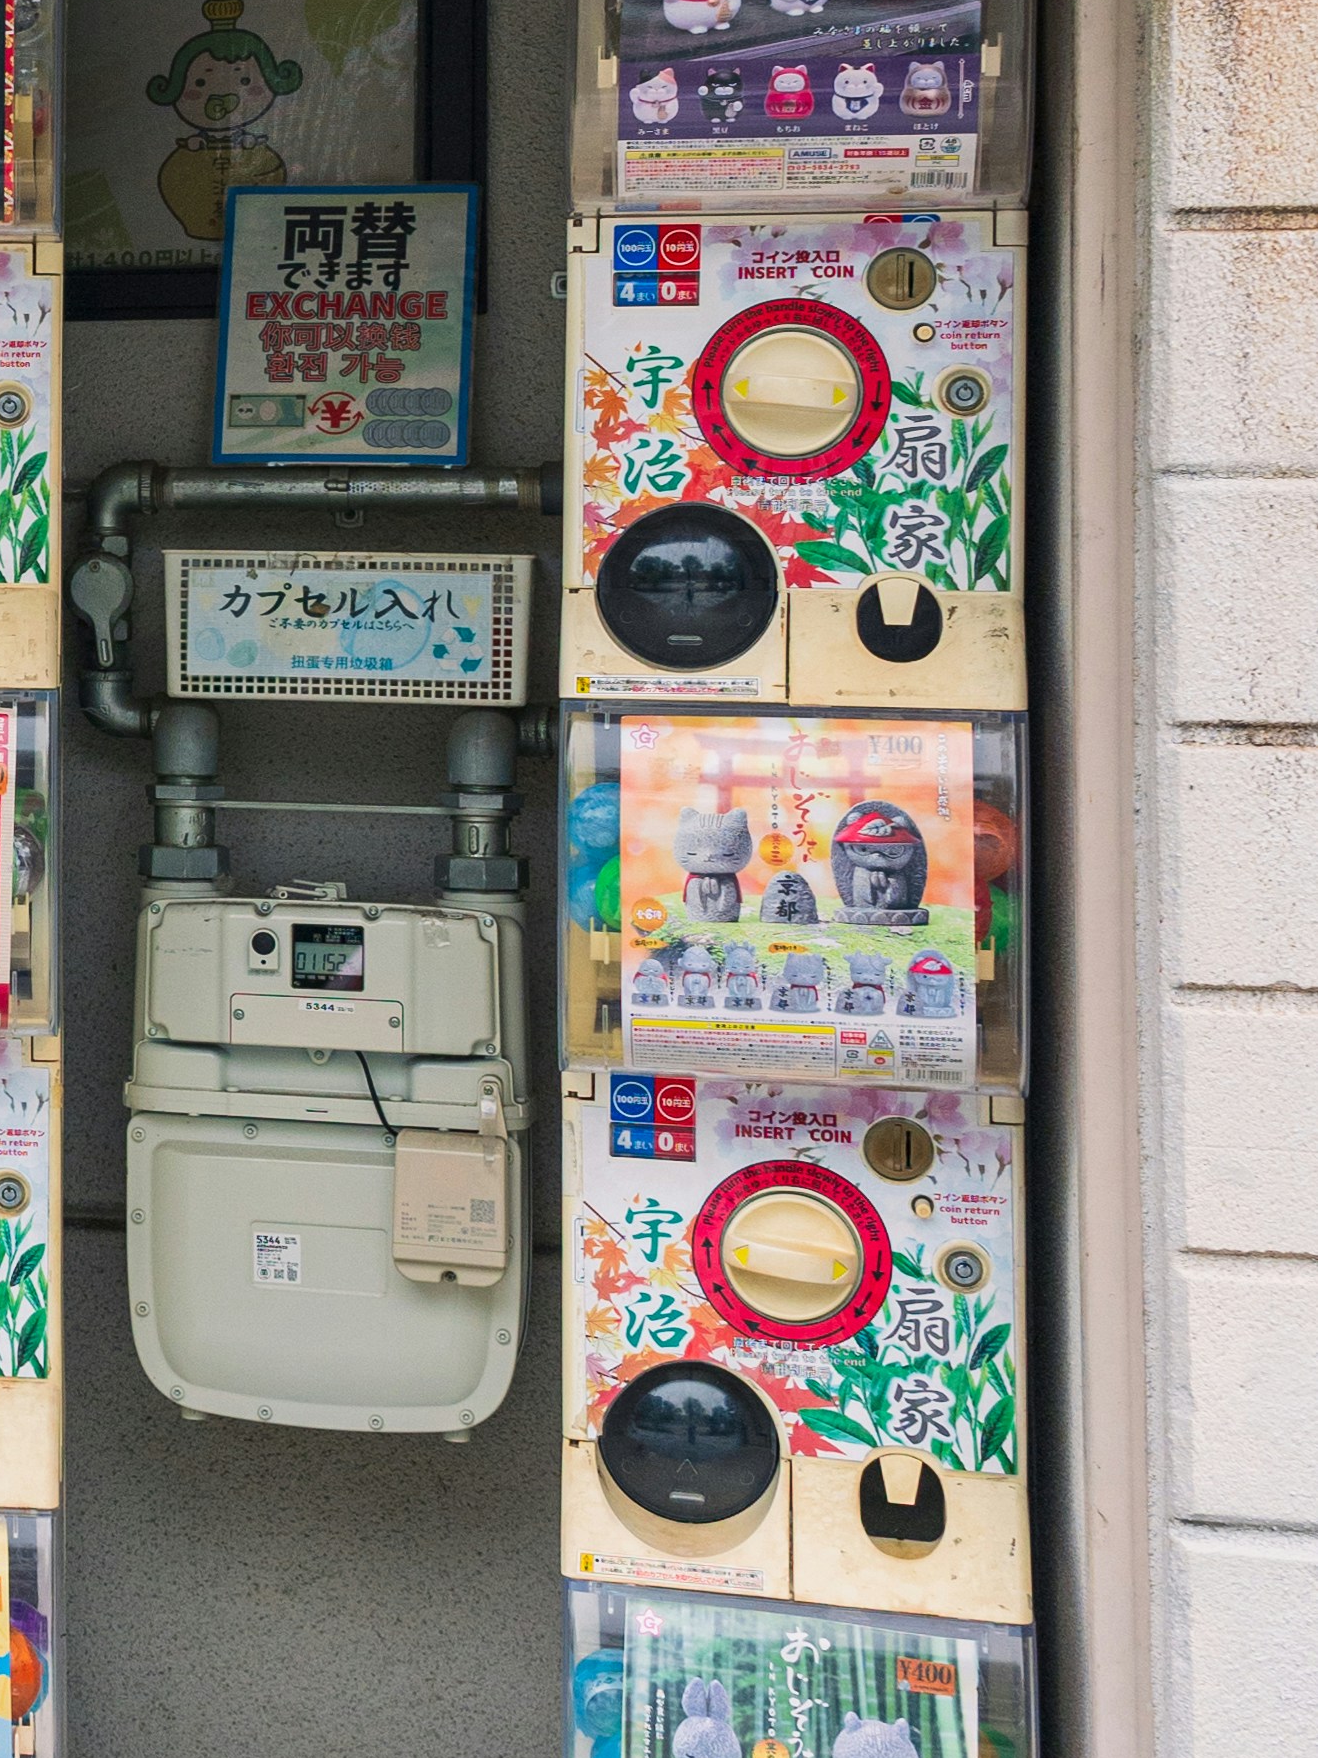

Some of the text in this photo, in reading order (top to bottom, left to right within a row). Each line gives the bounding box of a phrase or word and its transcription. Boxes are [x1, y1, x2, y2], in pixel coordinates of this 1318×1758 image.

[792, 149, 831, 159] AMUSE
[282, 201, 418, 261] 両替
[276, 259, 412, 292] できます
[245, 291, 449, 320] EXCHANGE
[260, 321, 423, 353] 你可以换钱
[0, 358, 31, 369] button
[267, 352, 405, 384] 환전 가능
[218, 583, 462, 622] カプセル入れ
[290, 654, 394, 673] 扭蛋专用垃圾箱
[305, 1002, 336, 1012] 5344
